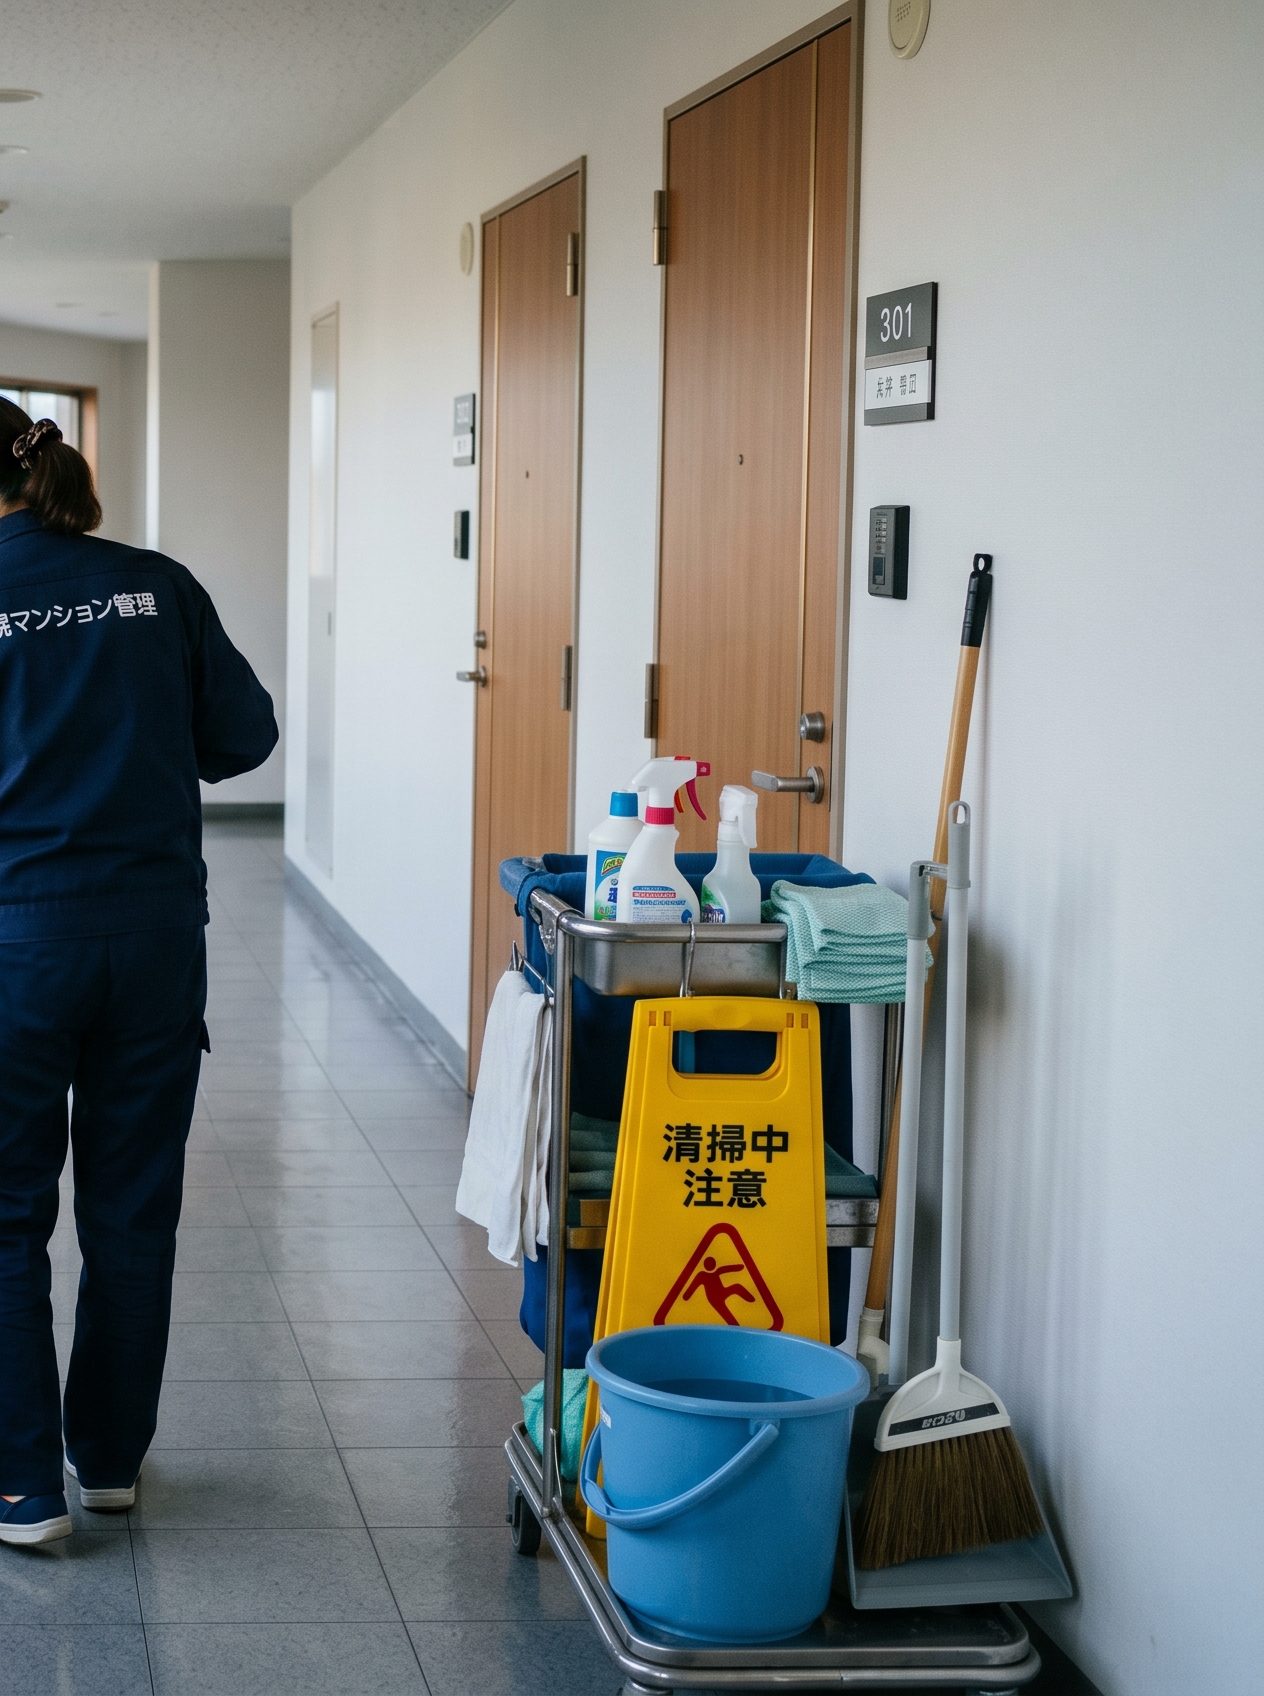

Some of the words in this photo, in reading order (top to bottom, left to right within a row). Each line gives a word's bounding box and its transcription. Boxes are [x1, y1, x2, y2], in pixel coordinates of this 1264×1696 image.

[880, 302, 912, 343] 301
[662, 1123, 789, 1163] 清掃中
[683, 1168, 767, 1208] 注意
